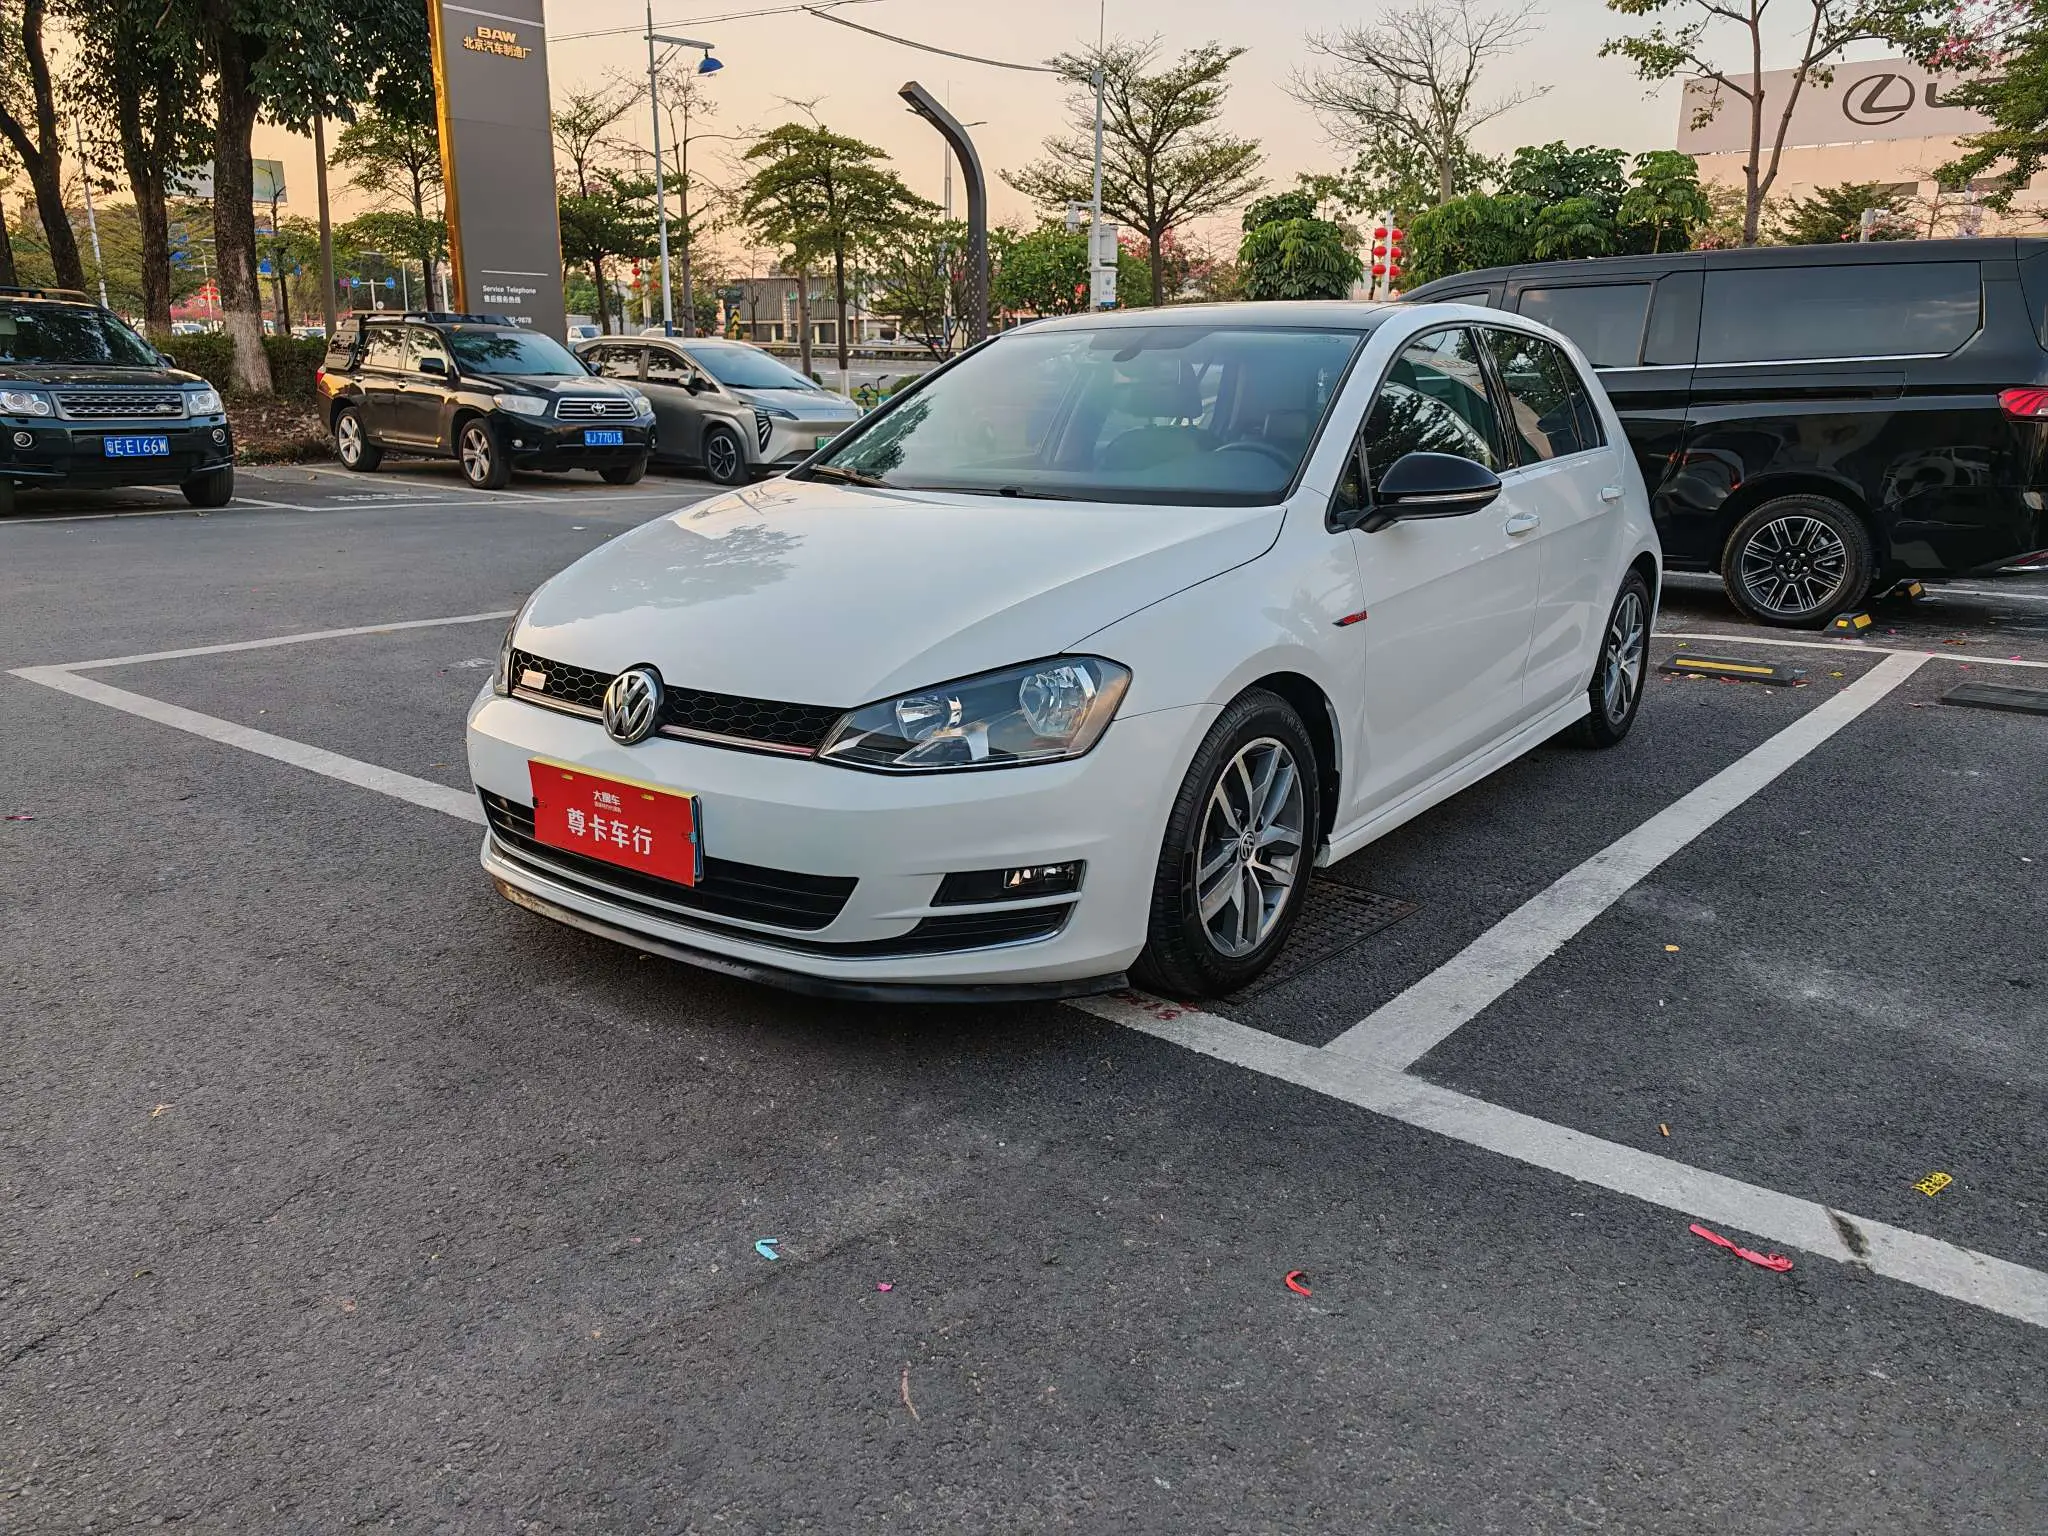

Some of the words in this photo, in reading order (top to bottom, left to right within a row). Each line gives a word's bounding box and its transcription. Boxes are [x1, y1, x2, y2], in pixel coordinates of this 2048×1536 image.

[476, 25, 516, 43] BAW
[463, 35, 532, 58] 北京汽车制造厂
[482, 284, 504, 292] Service
[506, 285, 537, 294] Telephone
[566, 807, 653, 856] 尊卡车行
